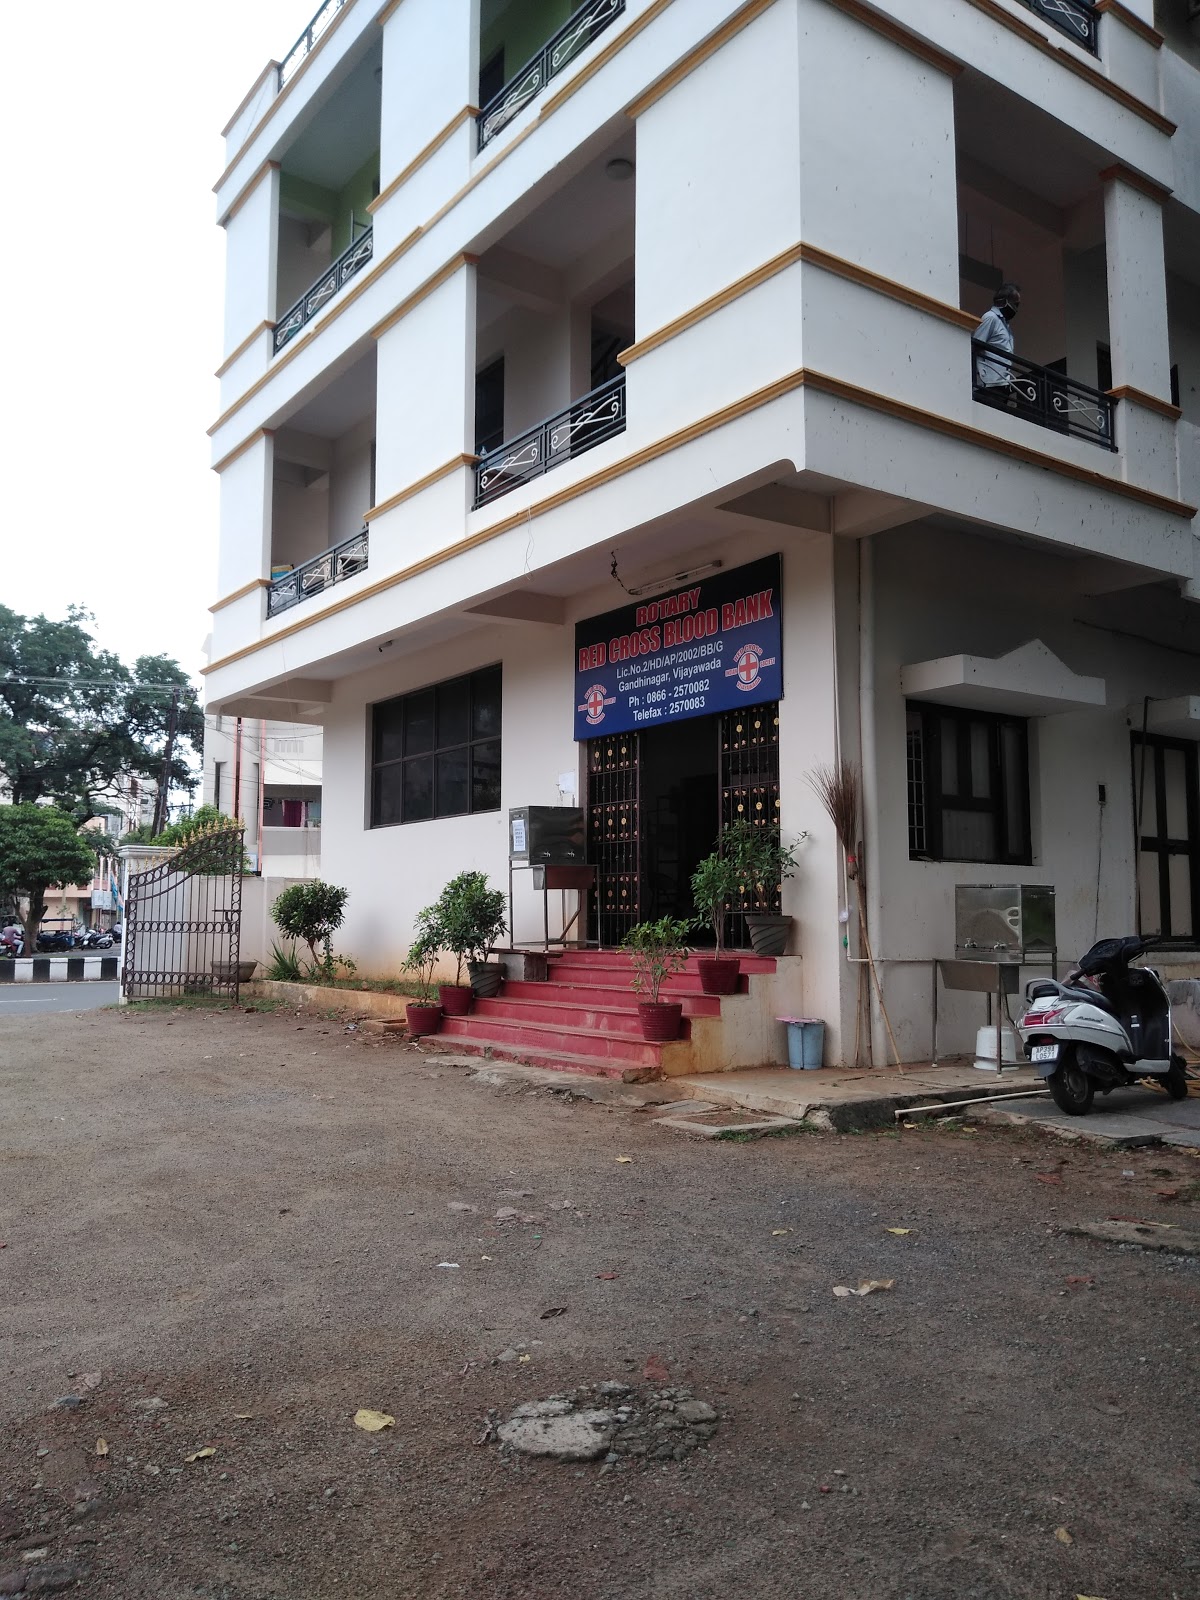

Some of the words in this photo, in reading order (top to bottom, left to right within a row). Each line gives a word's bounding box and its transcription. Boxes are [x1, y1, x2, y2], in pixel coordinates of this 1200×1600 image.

[636, 587, 701, 627] ROTARY
[579, 642, 607, 672] RED
[609, 626, 661, 663] CROSS
[664, 608, 719, 648] BLOOD
[722, 588, 774, 632] BANK
[616, 640, 724, 679] Lic.No.2/HD/AP/2002/BB/G
[618, 672, 671, 692] Gandhinagar,
[672, 657, 722, 680] Vijayawada
[628, 695, 640, 708] Ph
[646, 689, 667, 704] 0866
[673, 678, 710, 698] 2570082
[633, 706, 662, 721] Telefax
[669, 695, 706, 715] 2570083
